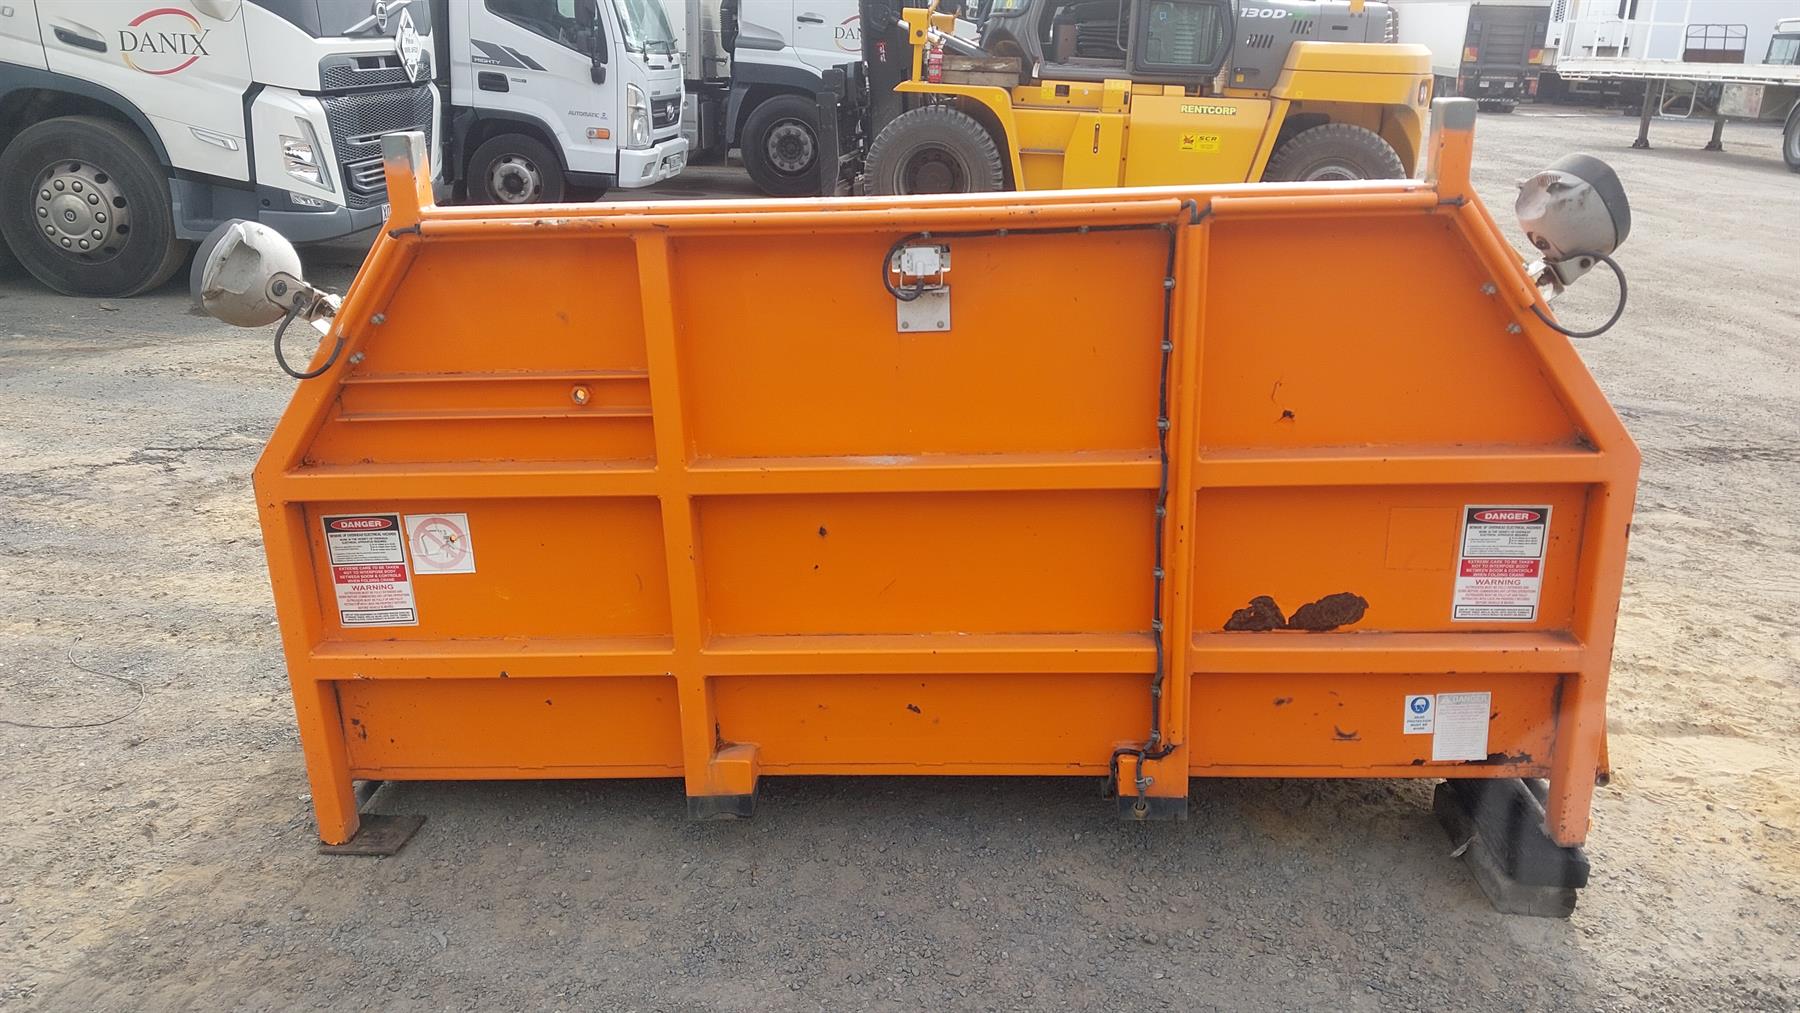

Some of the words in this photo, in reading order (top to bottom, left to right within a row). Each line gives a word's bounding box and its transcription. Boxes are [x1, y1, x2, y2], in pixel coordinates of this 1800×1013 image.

[118, 29, 210, 56] DANIX
[568, 110, 599, 118] AUTOMATIC
[1181, 104, 1237, 115] RENTCORP
